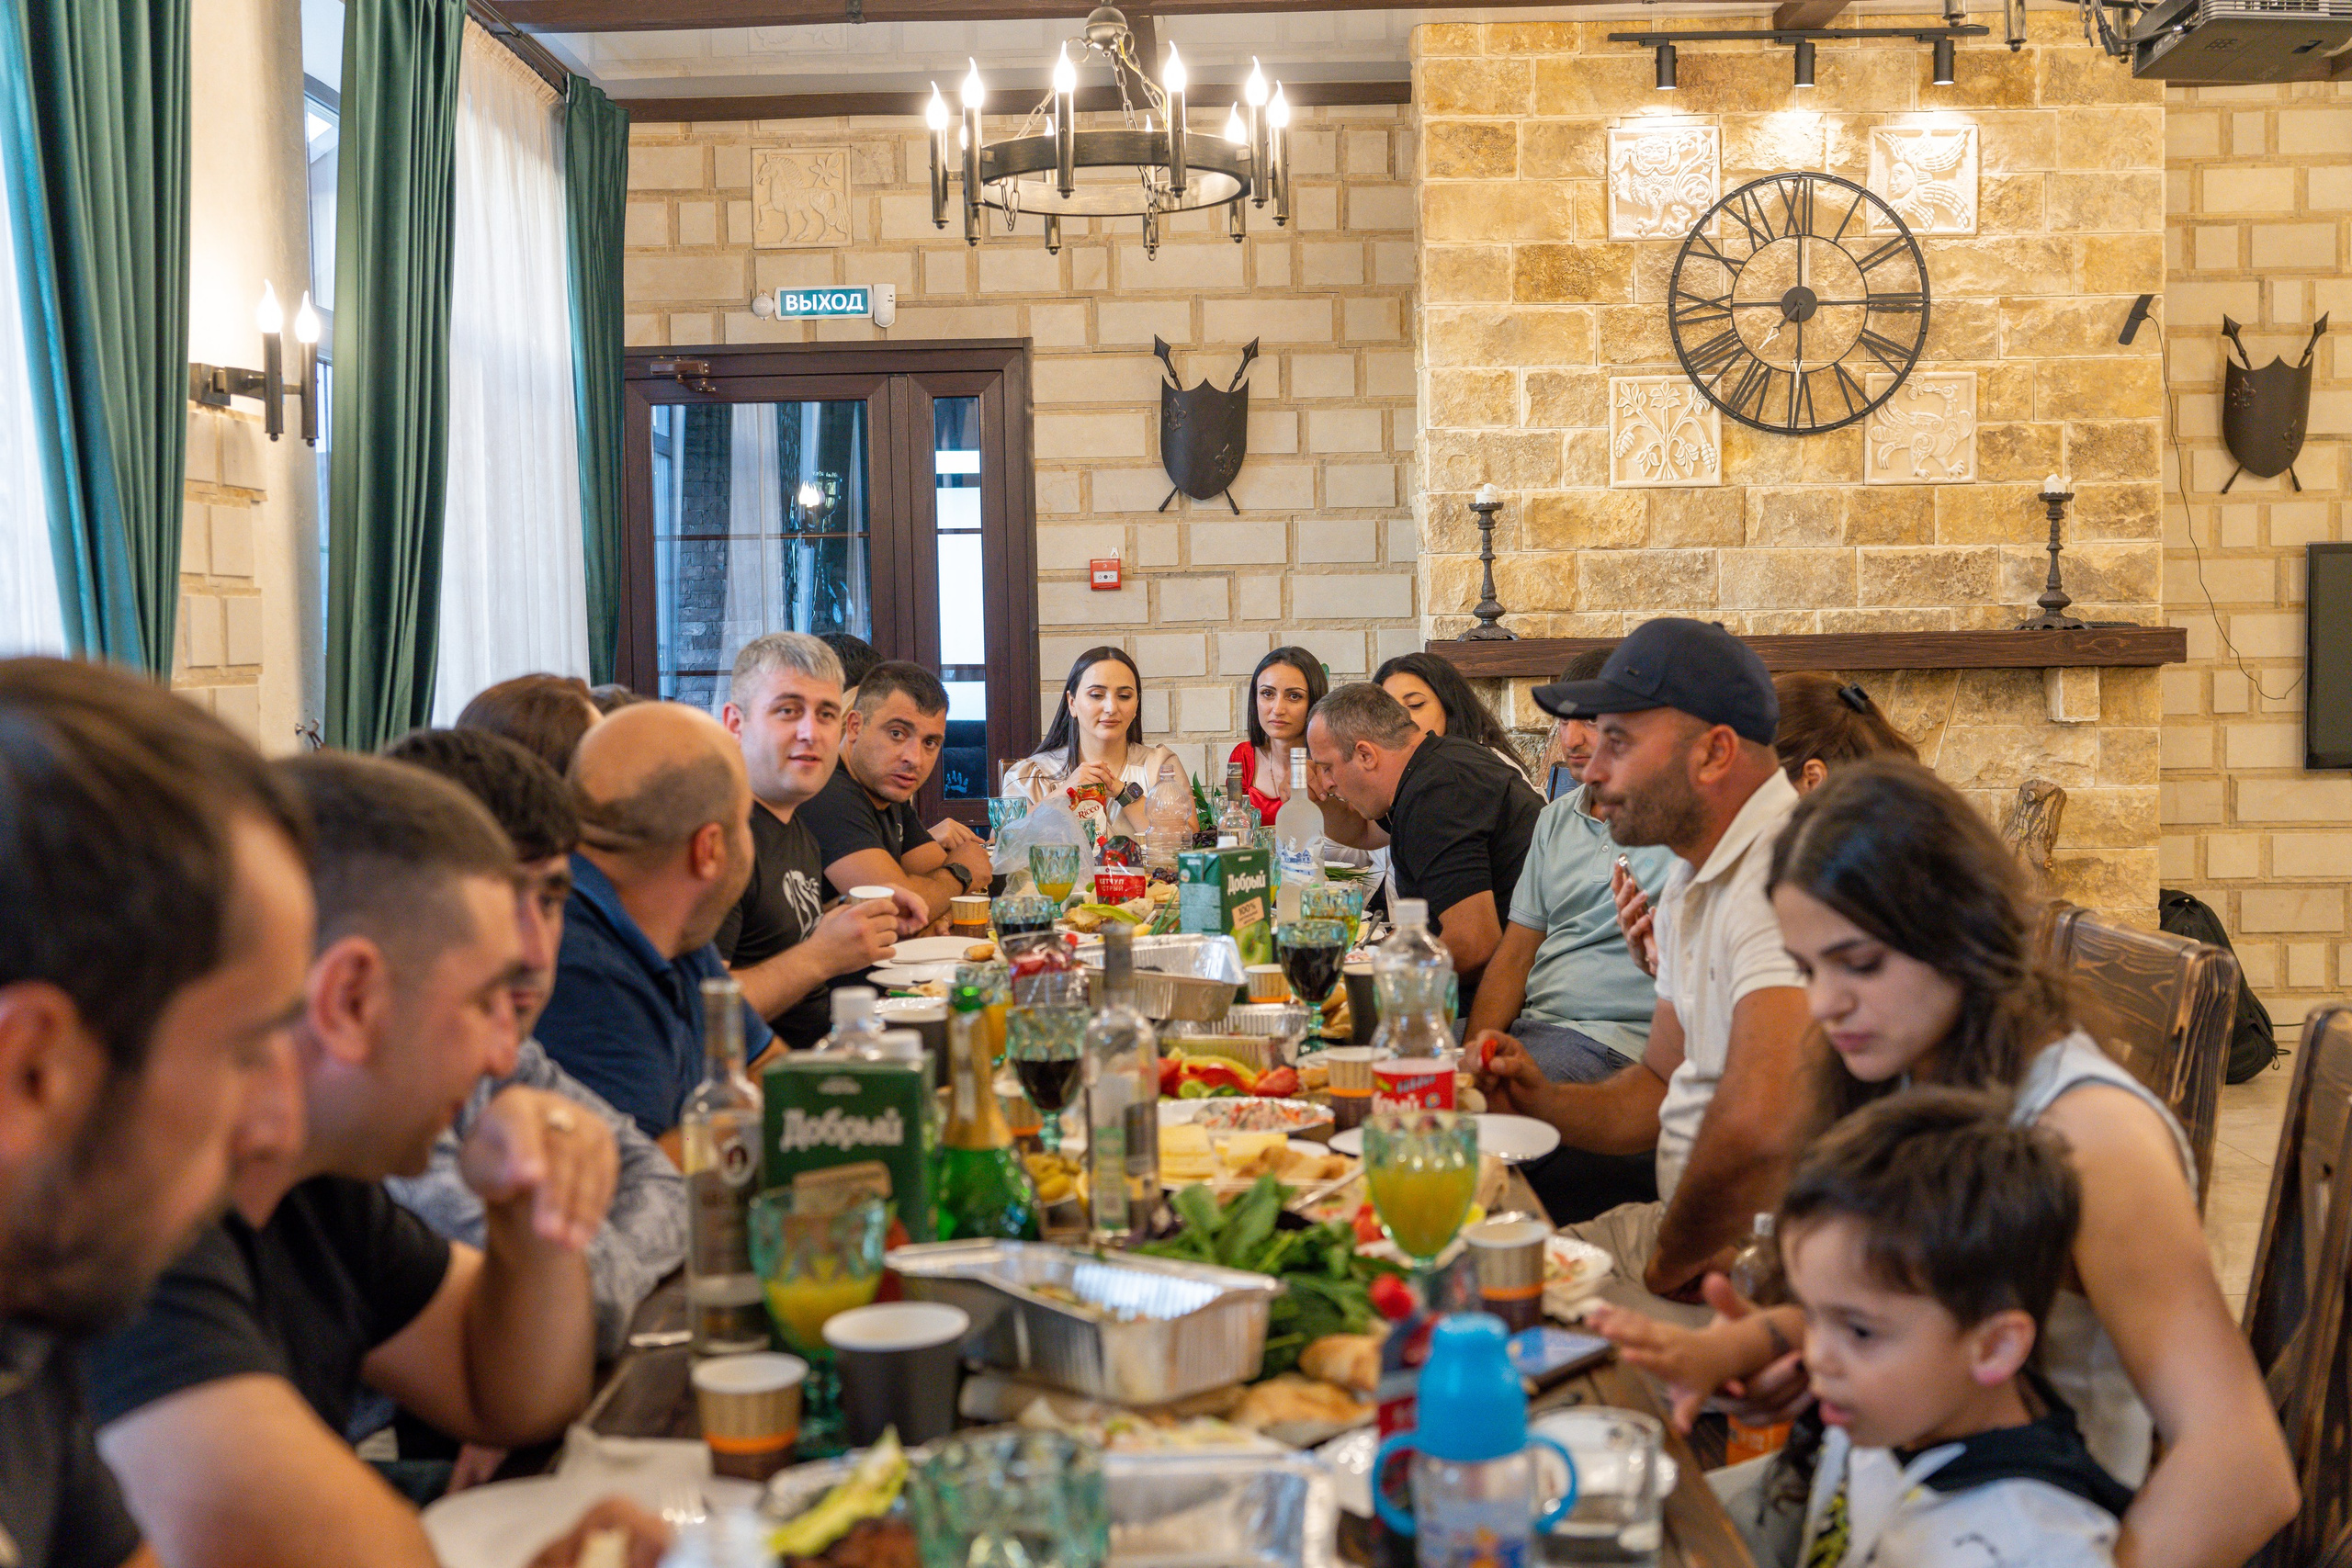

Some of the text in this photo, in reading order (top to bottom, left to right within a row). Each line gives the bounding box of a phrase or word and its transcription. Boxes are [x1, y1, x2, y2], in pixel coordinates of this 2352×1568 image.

[1721, 188, 1775, 253] XI
[1775, 175, 1814, 236] XII
[1687, 232, 1746, 276] X
[1857, 235, 1913, 274] II
[786, 293, 864, 311] ВЫХОД
[1675, 290, 1733, 325] IX
[1868, 292, 1925, 310] III
[1727, 358, 1771, 423] VII
[1788, 372, 1815, 429] VI
[1833, 363, 1872, 416] V
[1227, 869, 1267, 897] Добрый
